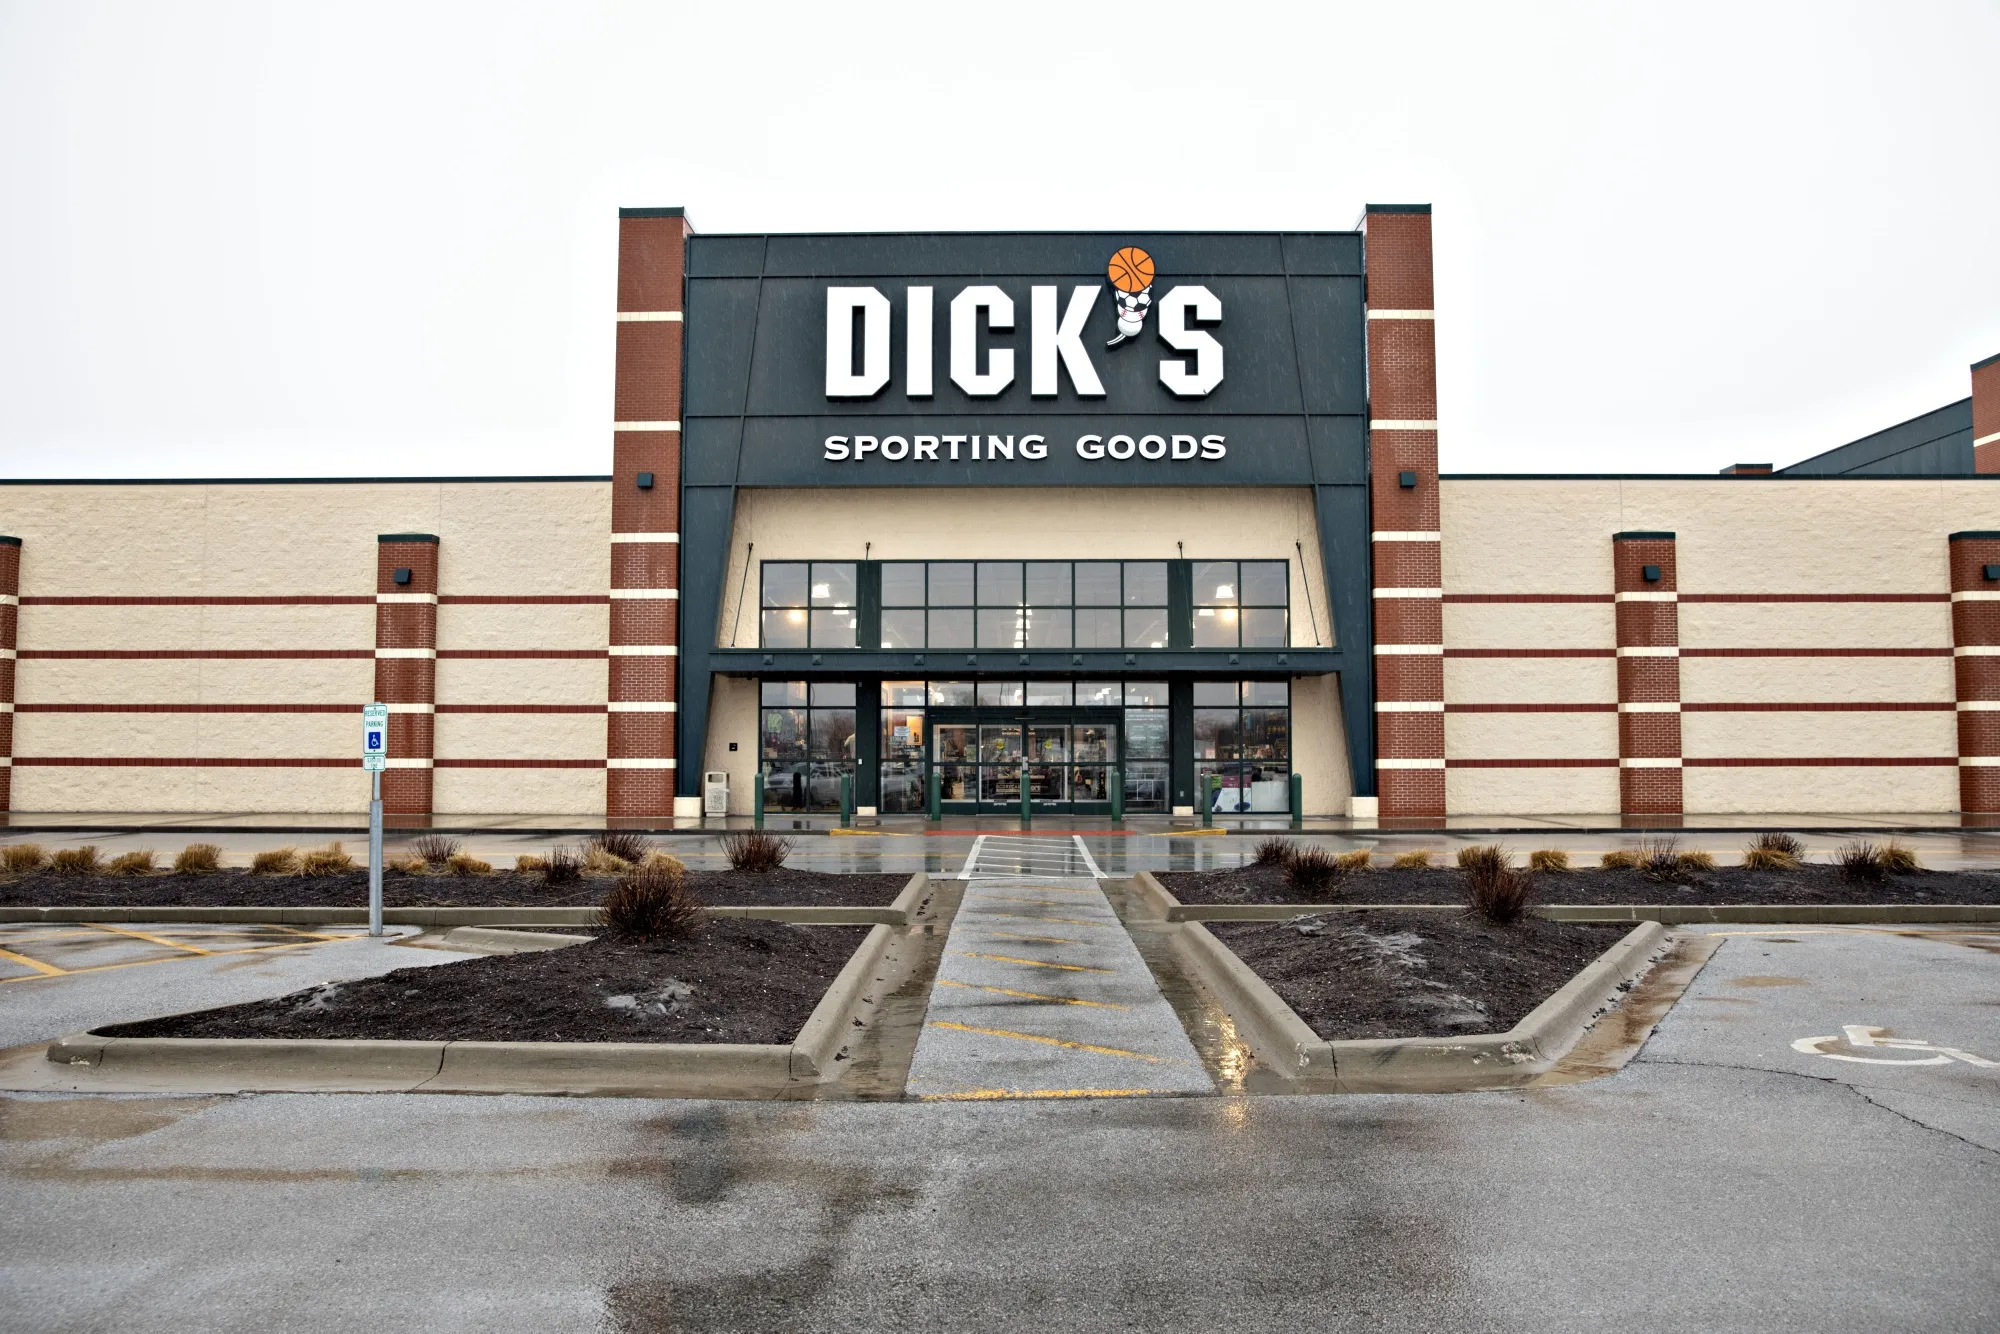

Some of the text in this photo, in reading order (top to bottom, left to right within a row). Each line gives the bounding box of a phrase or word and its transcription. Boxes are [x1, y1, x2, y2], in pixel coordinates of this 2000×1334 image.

[825, 246, 1225, 397] DICK'S
[823, 434, 1227, 461] SPORTING GOODS
